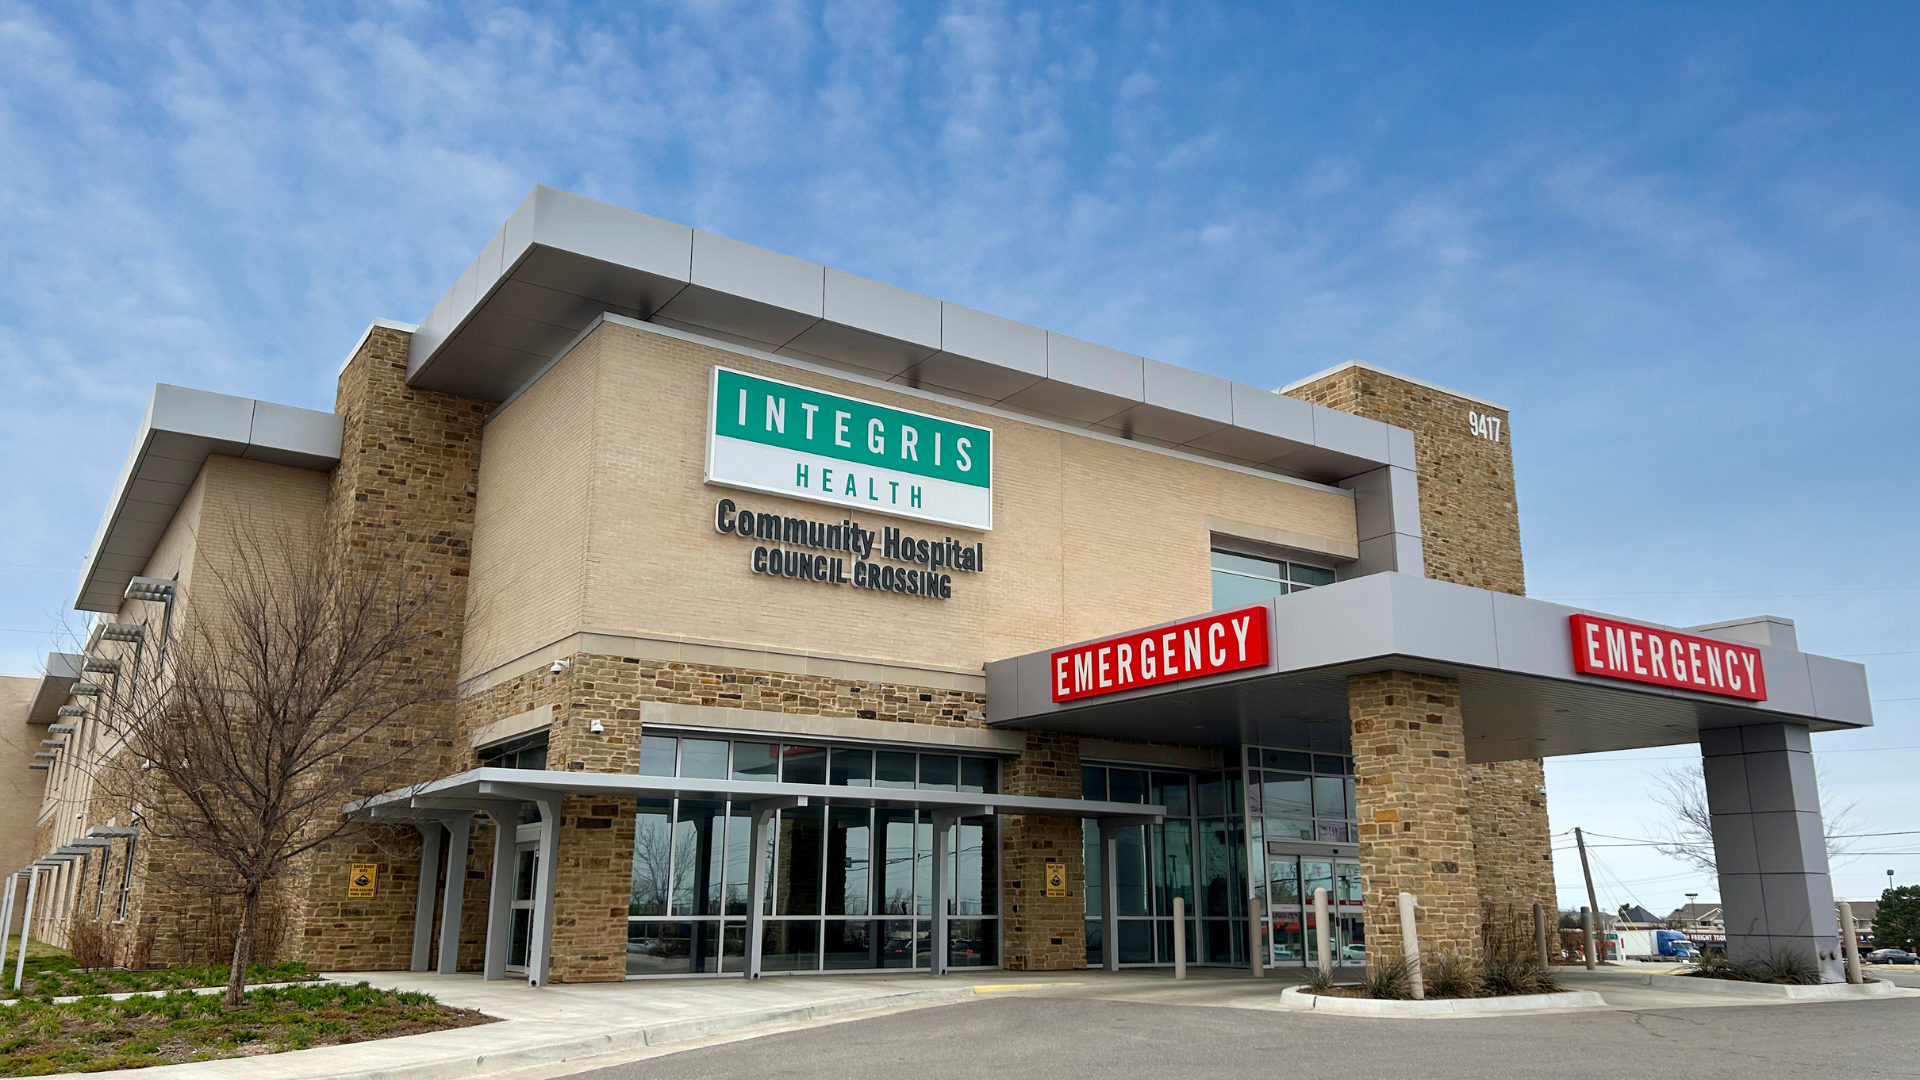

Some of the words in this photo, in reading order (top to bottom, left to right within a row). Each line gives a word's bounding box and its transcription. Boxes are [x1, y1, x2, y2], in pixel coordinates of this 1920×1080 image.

[738, 388, 972, 472] INTEGRIS
[1468, 410, 1501, 443] 9417
[796, 463, 922, 509] HEALTH
[716, 498, 875, 559] Community
[882, 526, 983, 572] Hospital
[752, 546, 847, 584] COUNCIL
[852, 561, 952, 599] CROSSING
[1056, 615, 1250, 696] EMERGENCY
[1585, 622, 1757, 693] EMERGENCY
